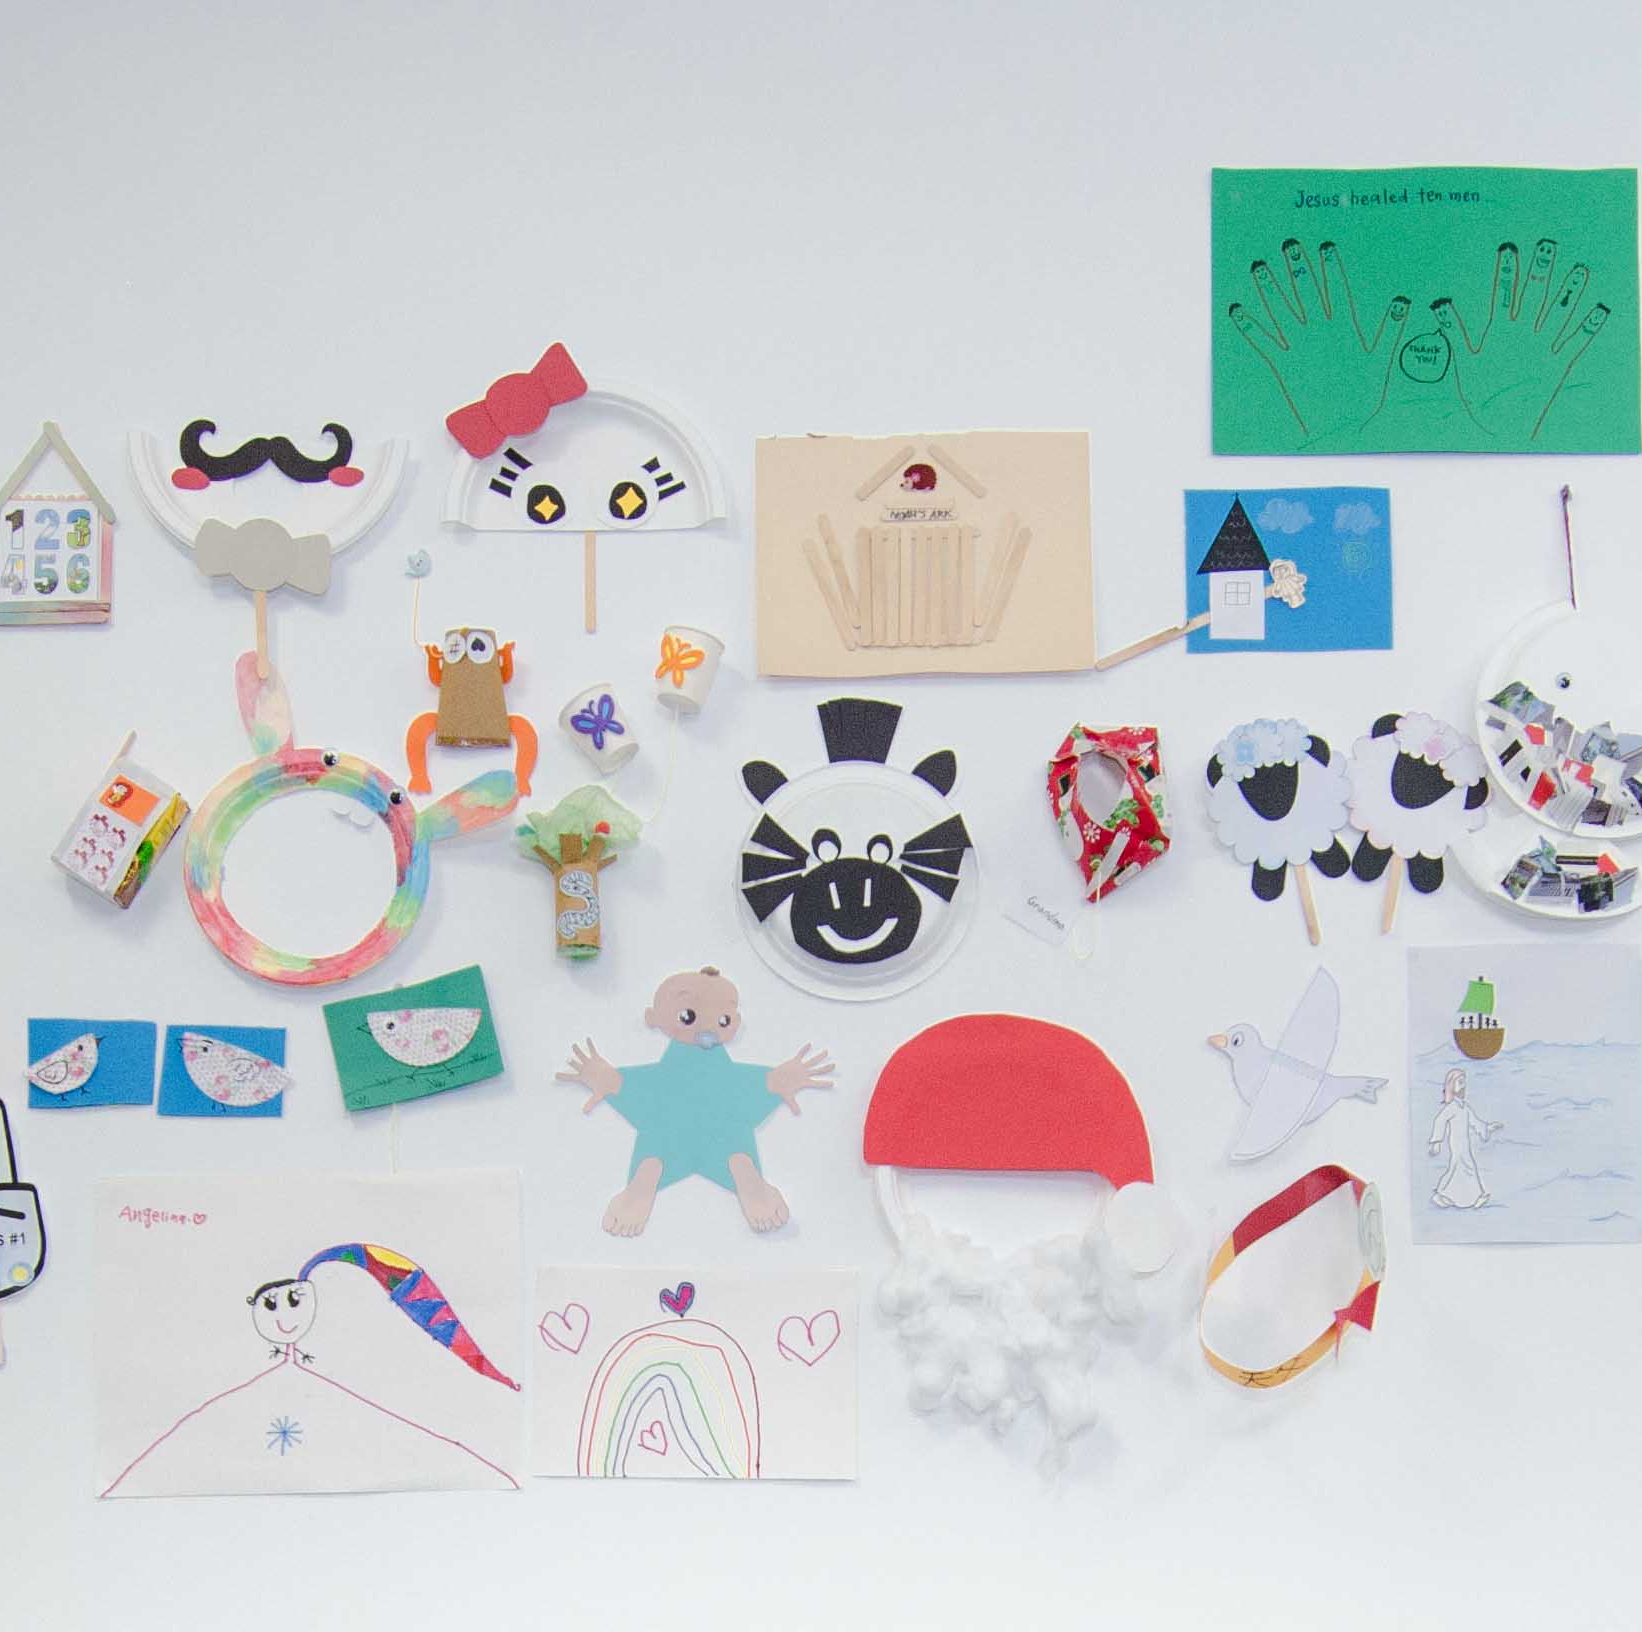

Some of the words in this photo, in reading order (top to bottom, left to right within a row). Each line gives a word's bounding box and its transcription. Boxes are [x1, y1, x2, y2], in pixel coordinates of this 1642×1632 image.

[1295, 190, 1340, 208] Jesus
[1350, 188, 1408, 206] healed
[1418, 187, 1442, 204] ten
[1449, 190, 1480, 203] men
[5, 509, 24, 550] 1
[35, 508, 61, 550] 2
[67, 508, 91, 549] 3
[0, 553, 28, 595] 4
[33, 553, 59, 595] 5
[66, 553, 91, 594] 6
[9, 1231, 26, 1246] #1
